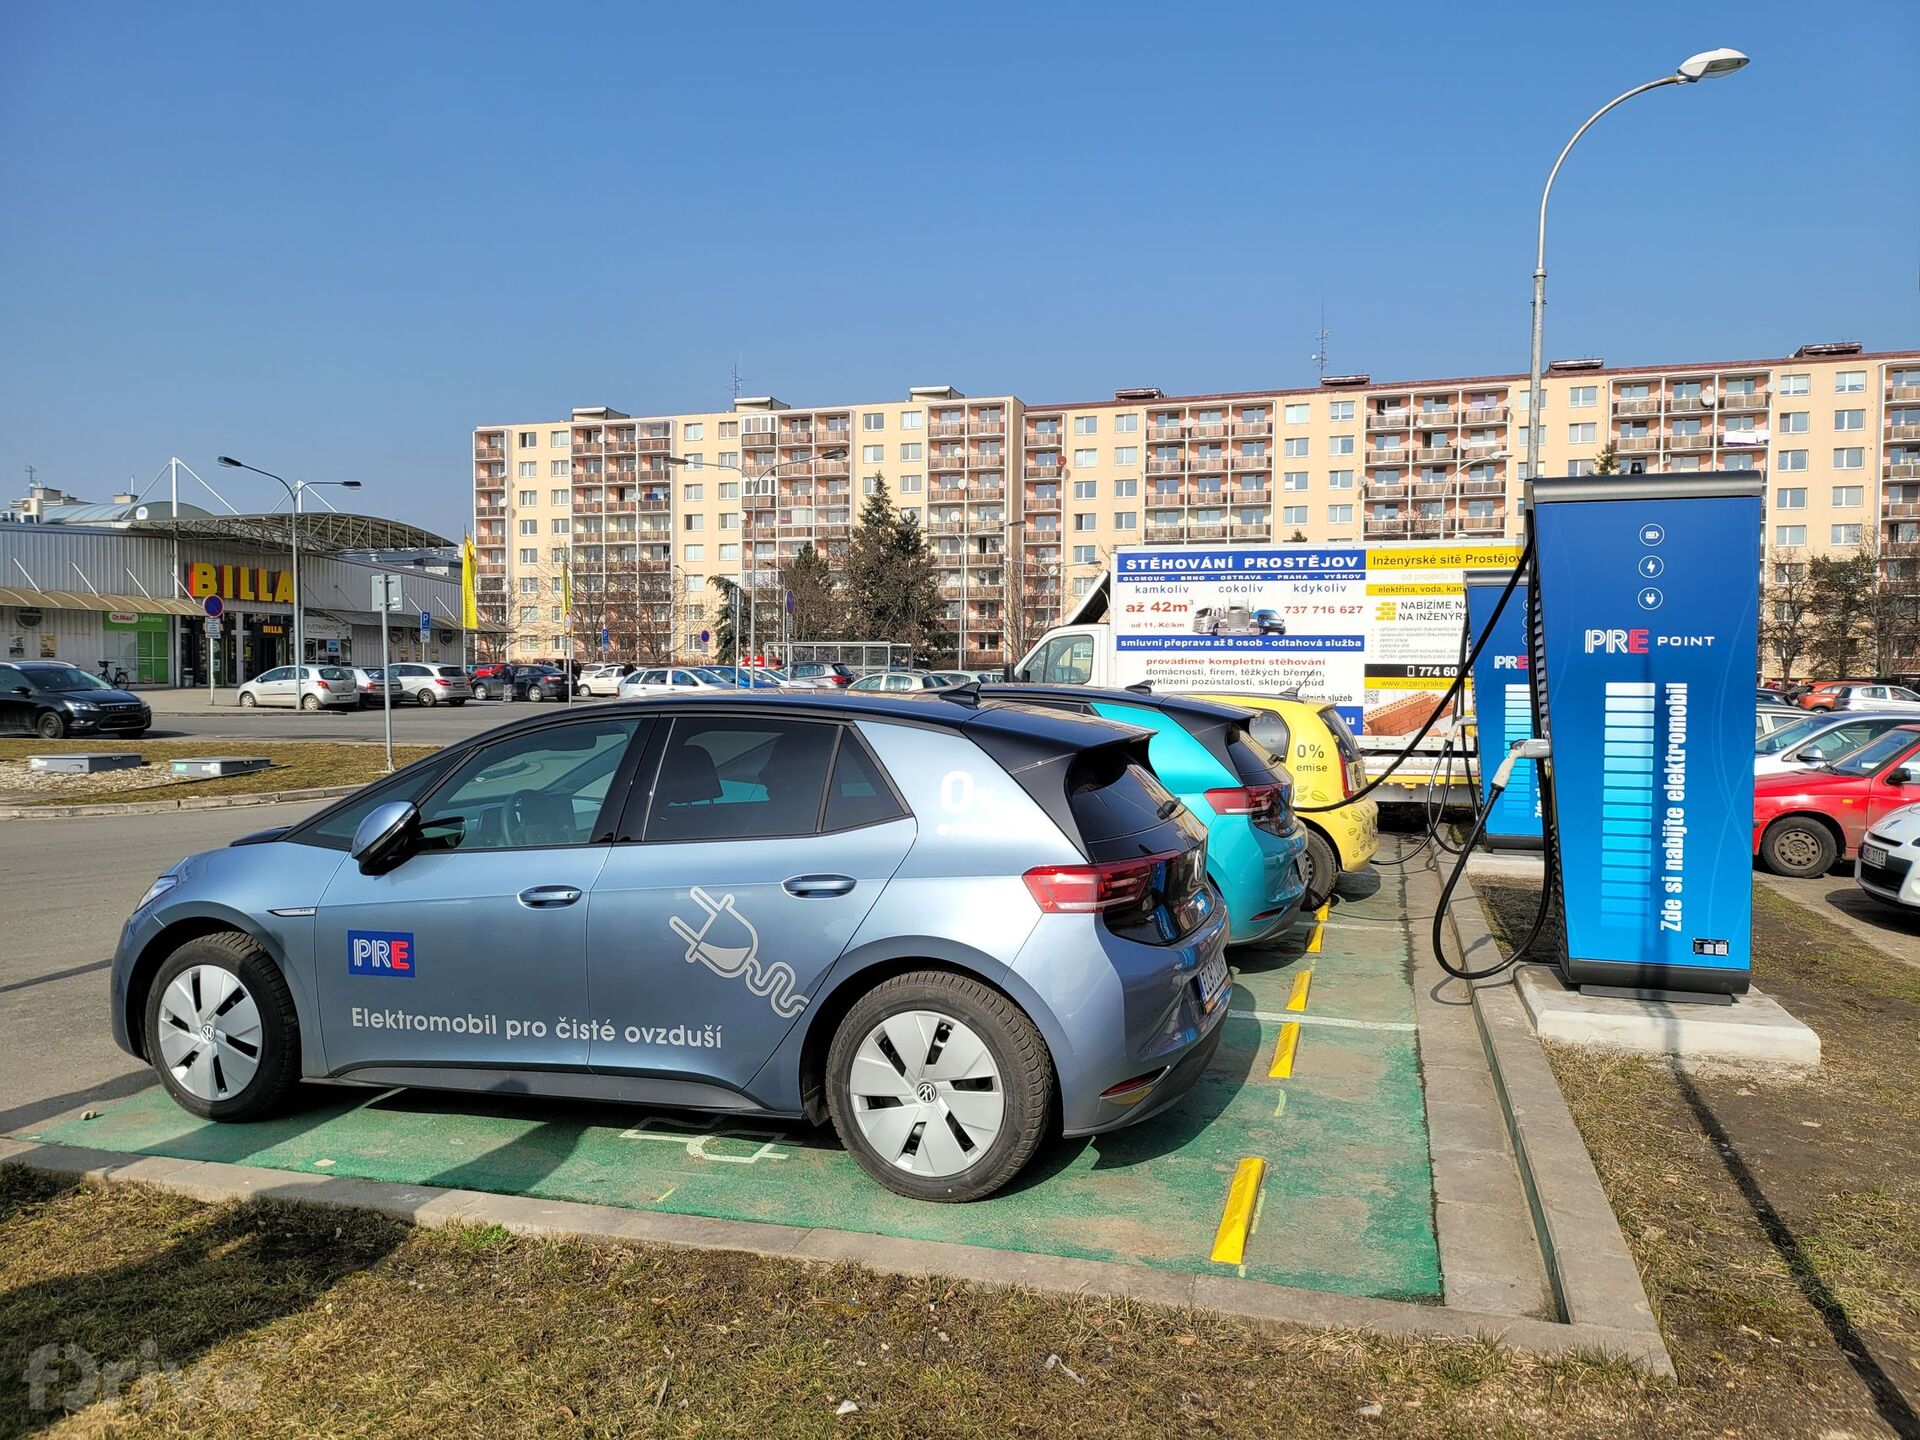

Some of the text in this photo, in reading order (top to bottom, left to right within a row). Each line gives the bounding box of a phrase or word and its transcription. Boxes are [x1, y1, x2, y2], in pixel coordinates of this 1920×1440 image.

[1126, 554, 1358, 570] STĚHOVÁNÍ PROSTĚJOV
[1373, 555, 1436, 567] Inženýrské
[190, 561, 295, 604] BILLA
[1135, 583, 1347, 595] kamkoliv cokoliv kdykoliv
[1420, 585, 1444, 594] voda,
[1125, 602, 1145, 613] až
[1284, 605, 1364, 614] 737 716 627
[1398, 612, 1414, 621] NA
[262, 625, 283, 634] BILLA
[1120, 638, 1161, 647] smluvní
[1164, 639, 1211, 648] přeprava
[1213, 638, 1225, 647] až
[1226, 638, 1234, 647] 8
[1235, 639, 1263, 647] osob
[1271, 638, 1323, 647] odtahová
[1325, 638, 1362, 647] služba
[1585, 629, 1715, 654] PRE POINT
[1208, 657, 1265, 666] kompletní
[1268, 657, 1326, 666] stěhování
[1494, 655, 1529, 669] PRE
[1241, 668, 1280, 677] těžkých
[1419, 666, 1441, 677] 774
[1328, 694, 1353, 702] služeb
[1663, 682, 1688, 801] elektromobil
[1296, 763, 1328, 772] emise
[1661, 807, 1688, 871] nabijte
[1661, 876, 1683, 893] si
[1660, 899, 1683, 932] Zde
[353, 938, 410, 970] PRE
[351, 1007, 723, 1049] Elektromobil pro čisté ovzduší
